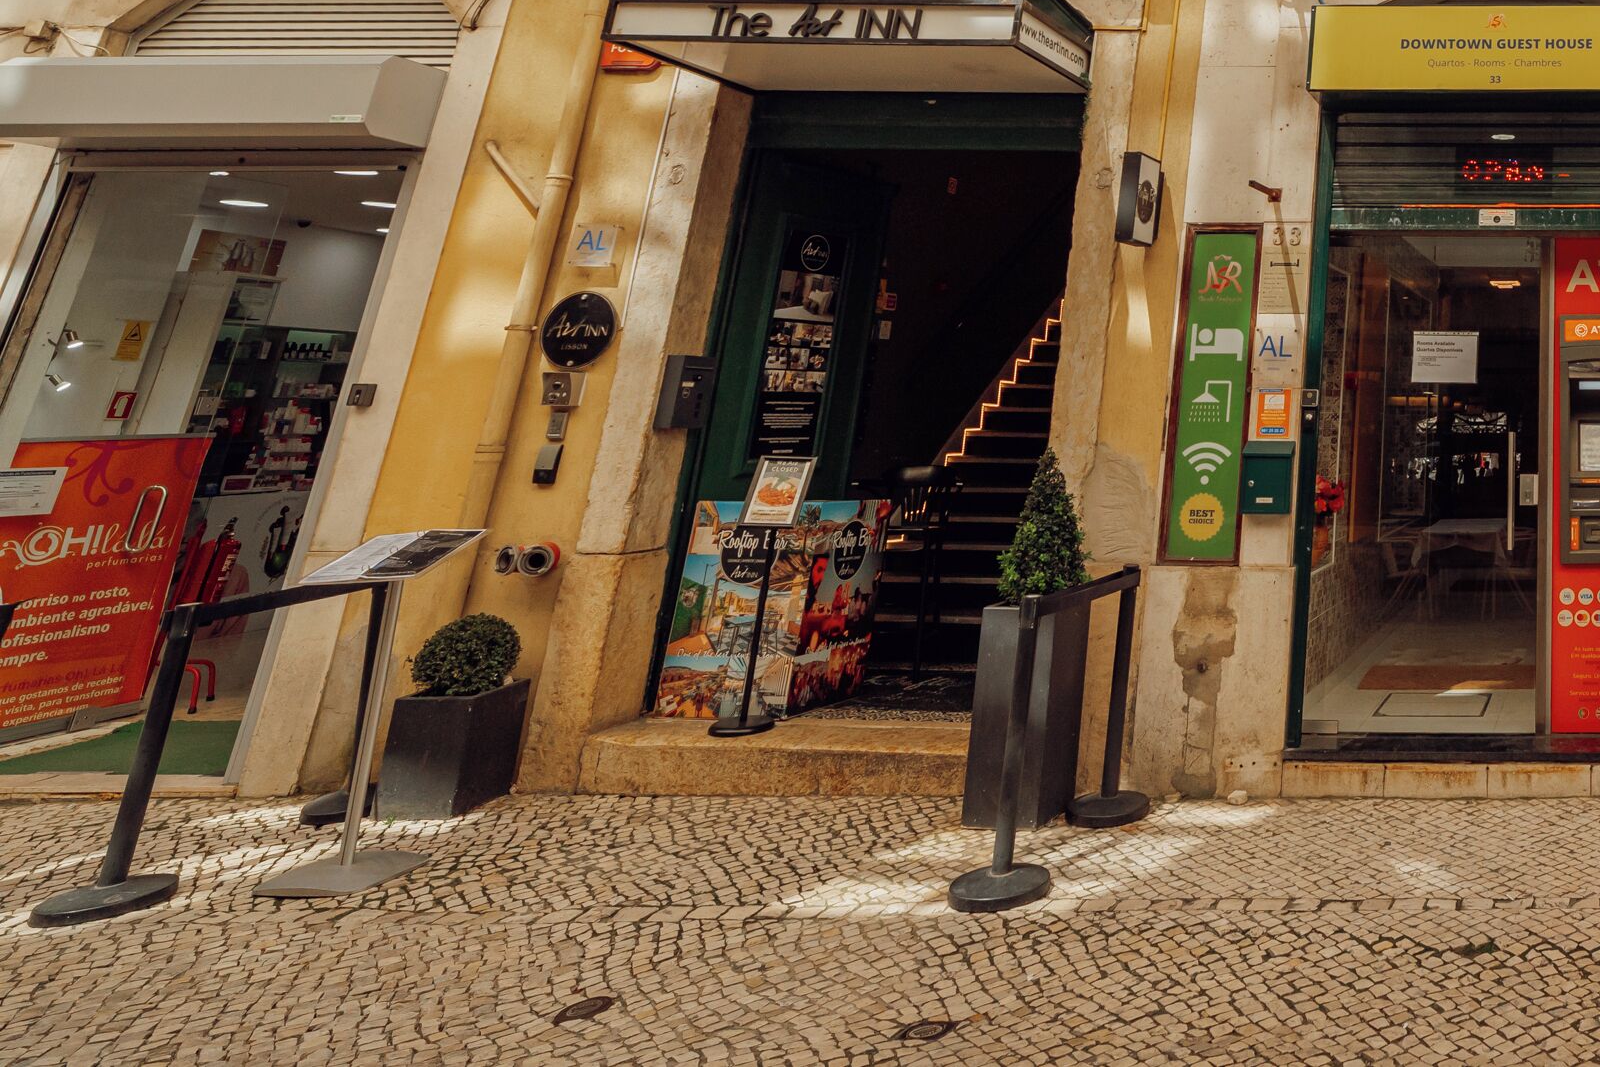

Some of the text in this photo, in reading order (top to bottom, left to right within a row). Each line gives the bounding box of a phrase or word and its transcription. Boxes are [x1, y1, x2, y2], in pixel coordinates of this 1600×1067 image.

[708, 4, 923, 40] The Art INN
[1400, 38, 1593, 50] DOWNTOWN GUEST HOUSE
[1427, 58, 1562, 68] Quartos Rooms Chambres
[1489, 75, 1502, 84] 33
[576, 230, 609, 251] AL
[1273, 227, 1301, 246] 33
[584, 324, 609, 337] INN
[1259, 335, 1292, 357] AL
[1189, 509, 1216, 518] BEST
[716, 530, 760, 558] Rooftop
[86, 554, 163, 572] perfumarias
[72, 594, 86, 603] no
[90, 586, 131, 602] rosto,
[10, 601, 154, 629] mbiente agradável,
[0, 623, 110, 649] ofissionalismo
[0, 651, 49, 667] empre.
[19, 685, 68, 704] gostamos
[71, 682, 84, 691] de
[86, 675, 123, 690] receber
[5, 703, 36, 715] visita,
[38, 698, 63, 711] para
